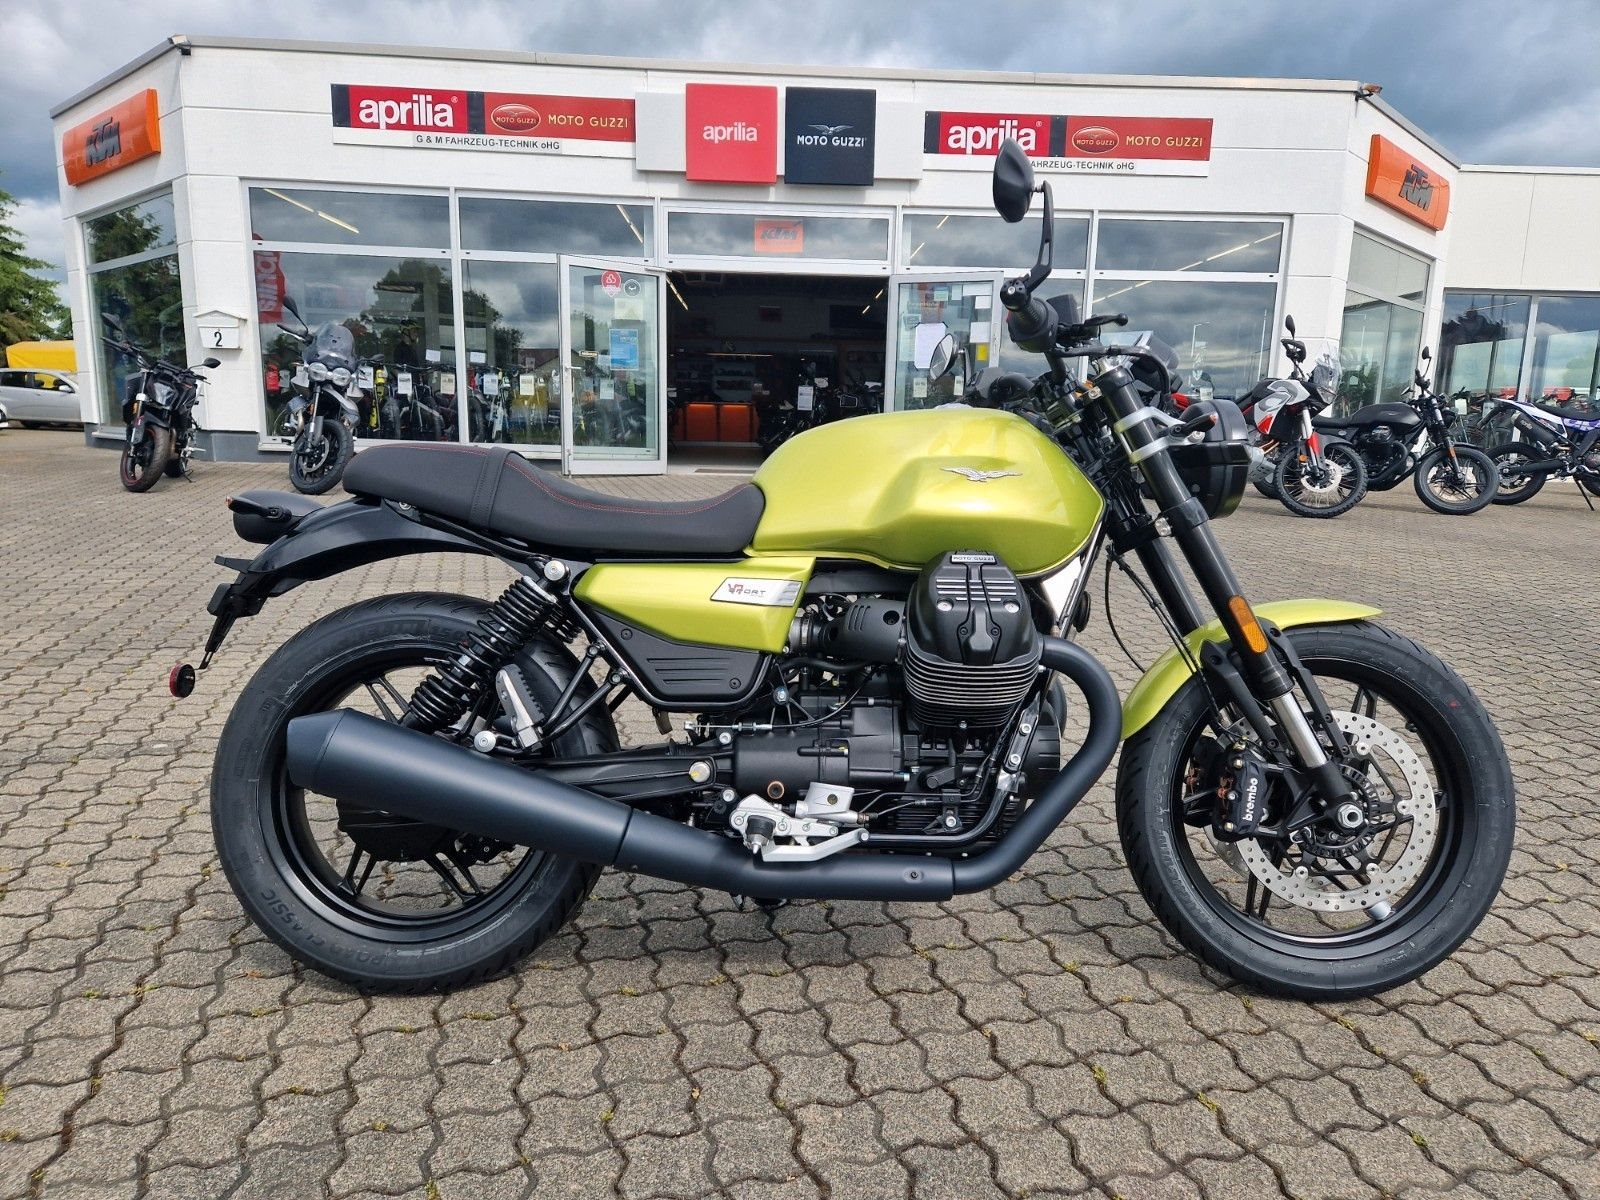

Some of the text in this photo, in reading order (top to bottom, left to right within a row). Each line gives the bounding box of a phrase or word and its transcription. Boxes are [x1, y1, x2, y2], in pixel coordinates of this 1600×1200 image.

[358, 94, 454, 130] aprilia
[548, 114, 629, 129] MOTO GUZZI
[702, 121, 758, 144] aprilia
[947, 119, 1036, 155] aprilia
[85, 116, 121, 168] KTM
[416, 134, 424, 144] G
[425, 136, 433, 144] &
[435, 136, 443, 144] M
[445, 136, 538, 150] FAHRZEUG-TECHNIK
[796, 134, 864, 148] MOTO GUZZI
[1095, 139, 1116, 147] GUZZI
[1126, 135, 1203, 148] MOTO GUZZI
[1031, 160, 1114, 170] AHRZEUG-TECHNIK
[1398, 164, 1434, 211] KTM
[213, 331, 223, 347] 2
[1242, 777, 1259, 822] brembo
